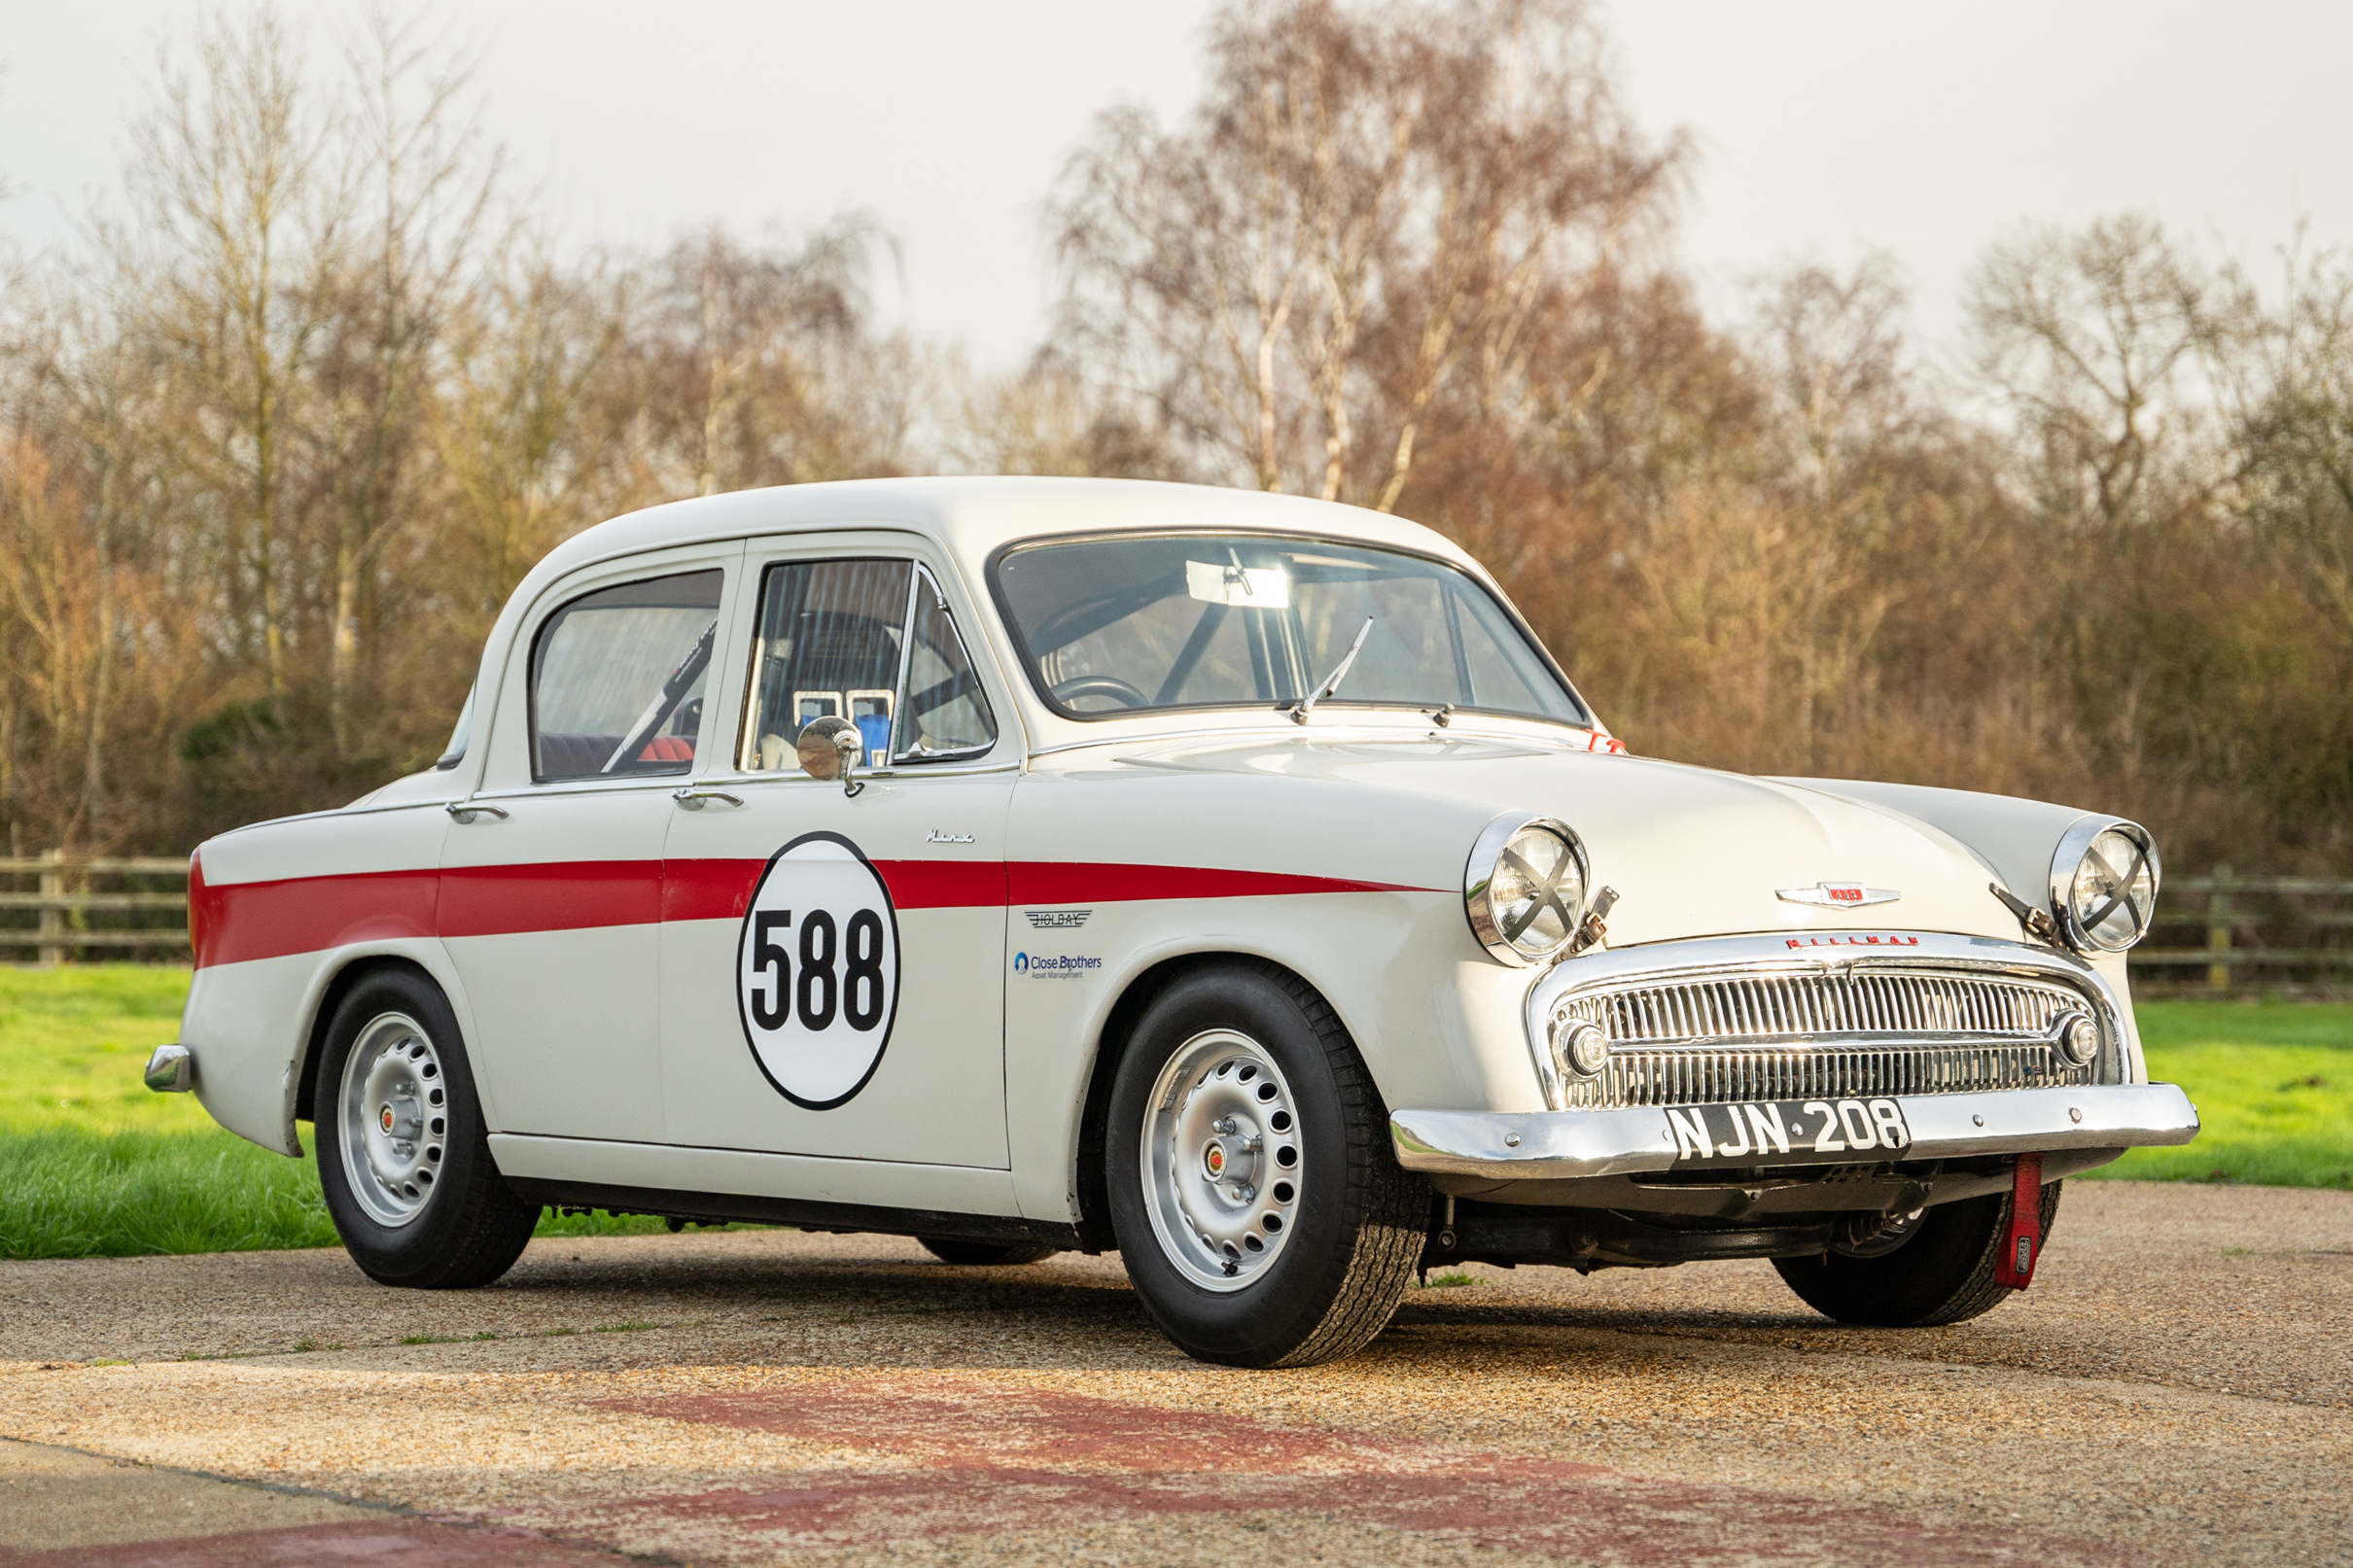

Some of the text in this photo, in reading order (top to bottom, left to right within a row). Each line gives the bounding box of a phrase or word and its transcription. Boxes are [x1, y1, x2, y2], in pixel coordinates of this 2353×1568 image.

[1785, 935, 1919, 950] HILLMAN
[751, 908, 884, 1031] 588
[1031, 955, 1103, 969] Close Brothers
[1048, 971, 1083, 981] Management
[1667, 1098, 1909, 1160] NJN 208
